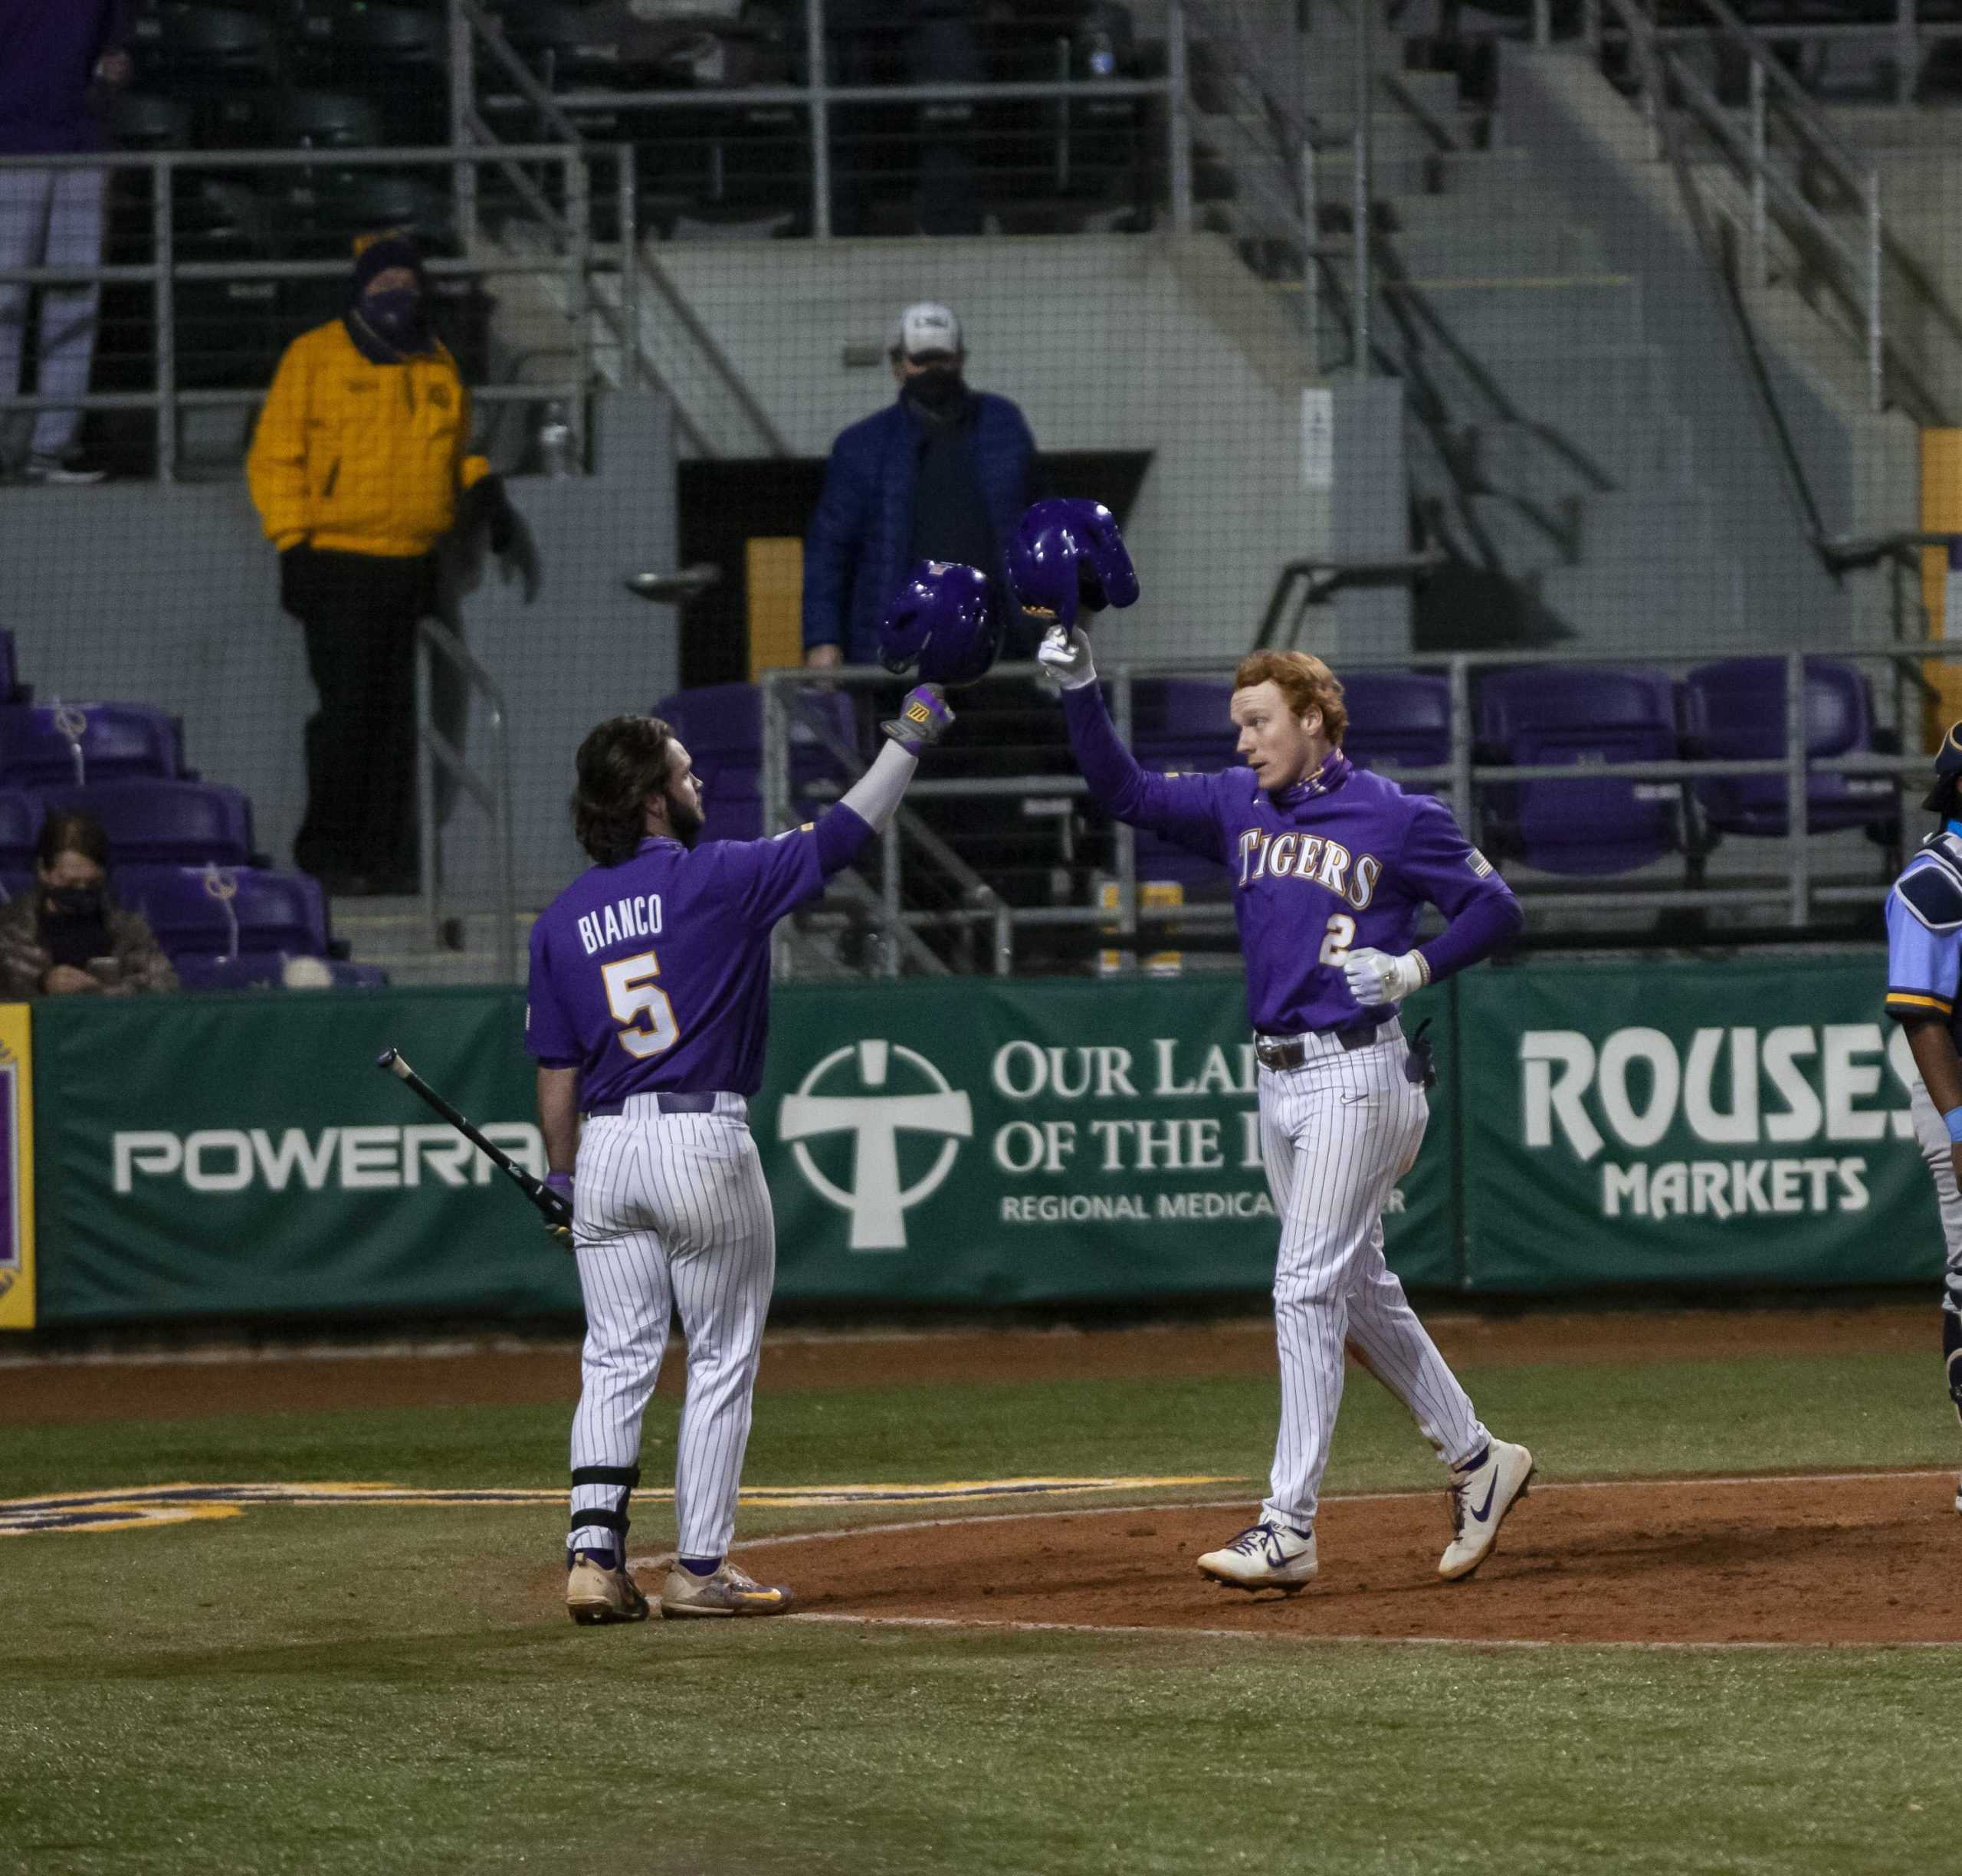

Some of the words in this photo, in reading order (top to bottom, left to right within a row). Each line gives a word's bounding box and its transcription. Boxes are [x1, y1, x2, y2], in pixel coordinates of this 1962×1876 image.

[1239, 828, 1383, 910] TIGERS
[578, 894, 662, 955] BIANCO
[1319, 913, 1356, 967] 2
[601, 950, 681, 1058] 5
[993, 1040, 1140, 1097] OUR
[994, 1120, 1077, 1172] OF
[1091, 1119, 1225, 1171] THE
[1002, 1195, 1149, 1222] REGIONAL
[1158, 1192, 1278, 1218] MEDICA
[1604, 1157, 1870, 1220] MARKETS
